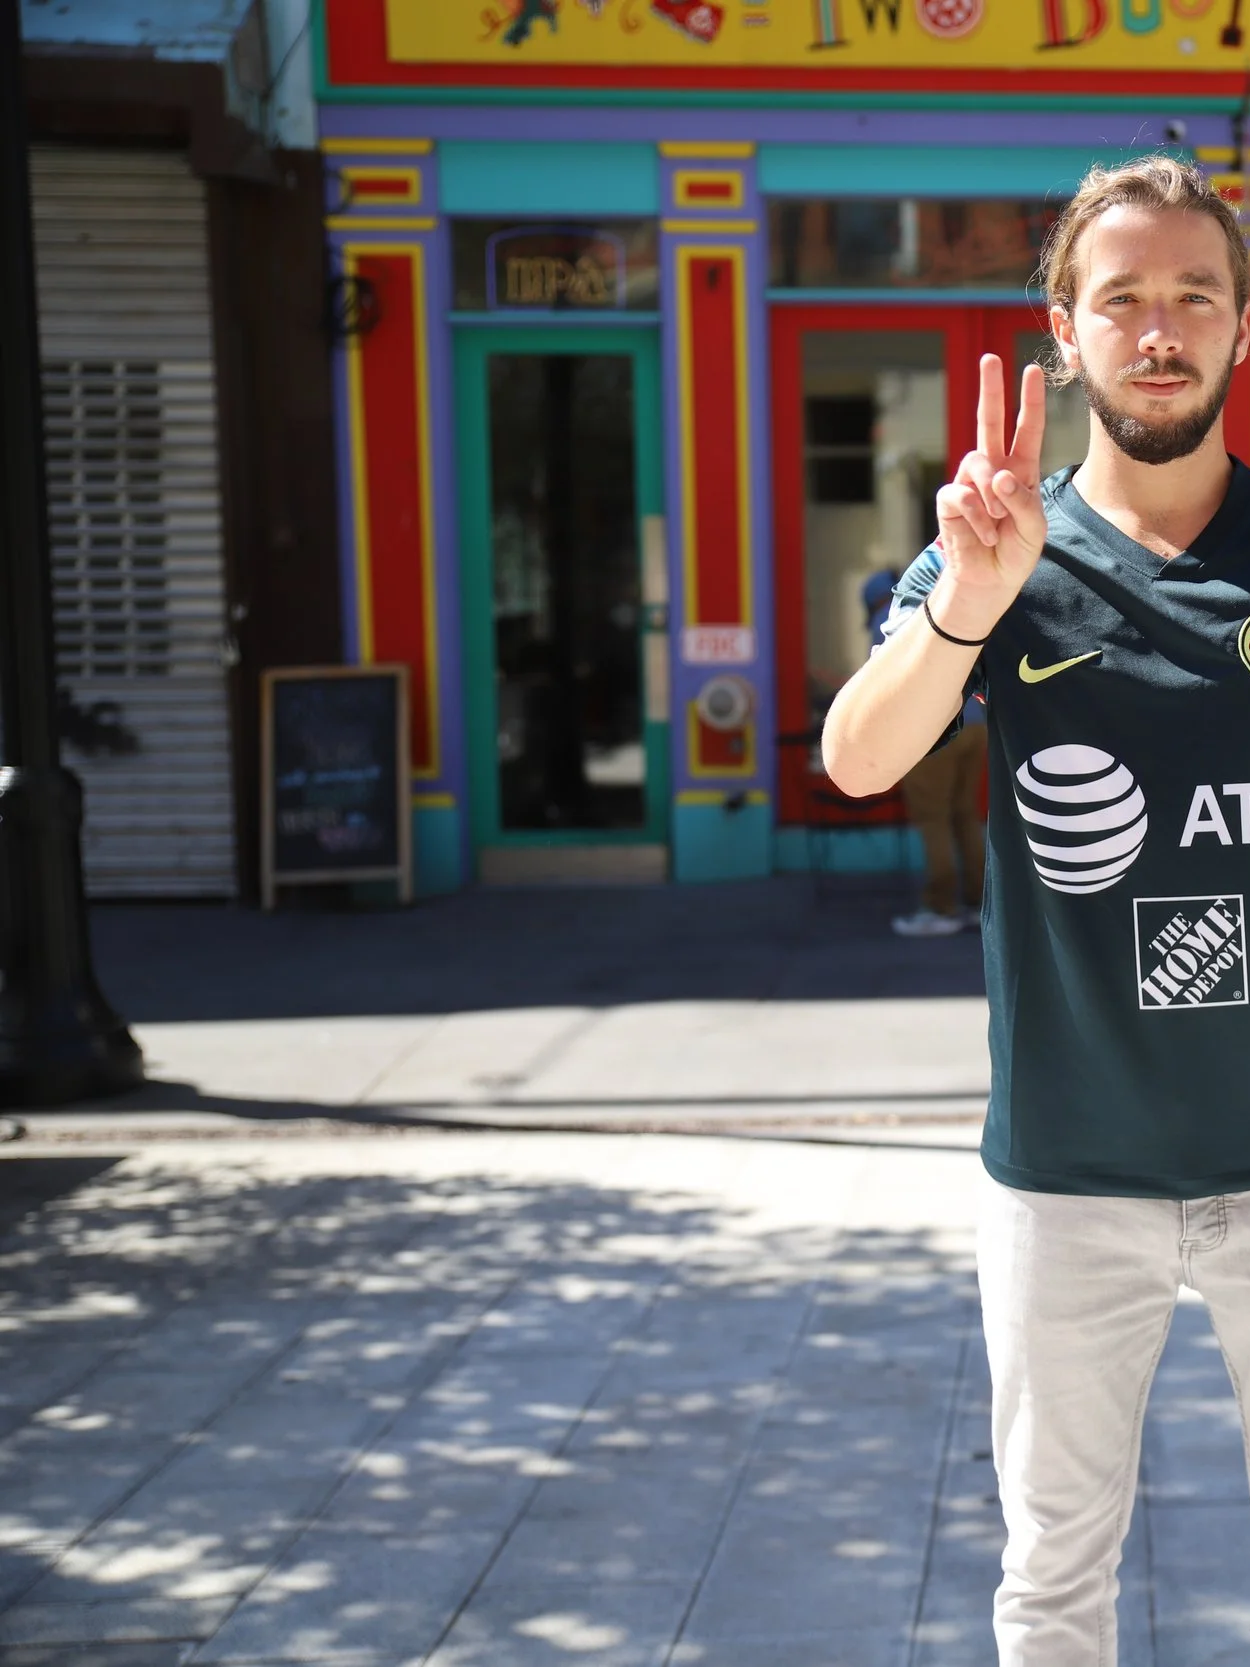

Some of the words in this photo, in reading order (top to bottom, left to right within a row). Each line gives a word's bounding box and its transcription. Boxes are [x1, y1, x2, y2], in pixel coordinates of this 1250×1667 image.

[1140, 898, 1241, 1006] HOME
[1148, 911, 1193, 956] THE
[1182, 939, 1244, 1005] DEPOT
